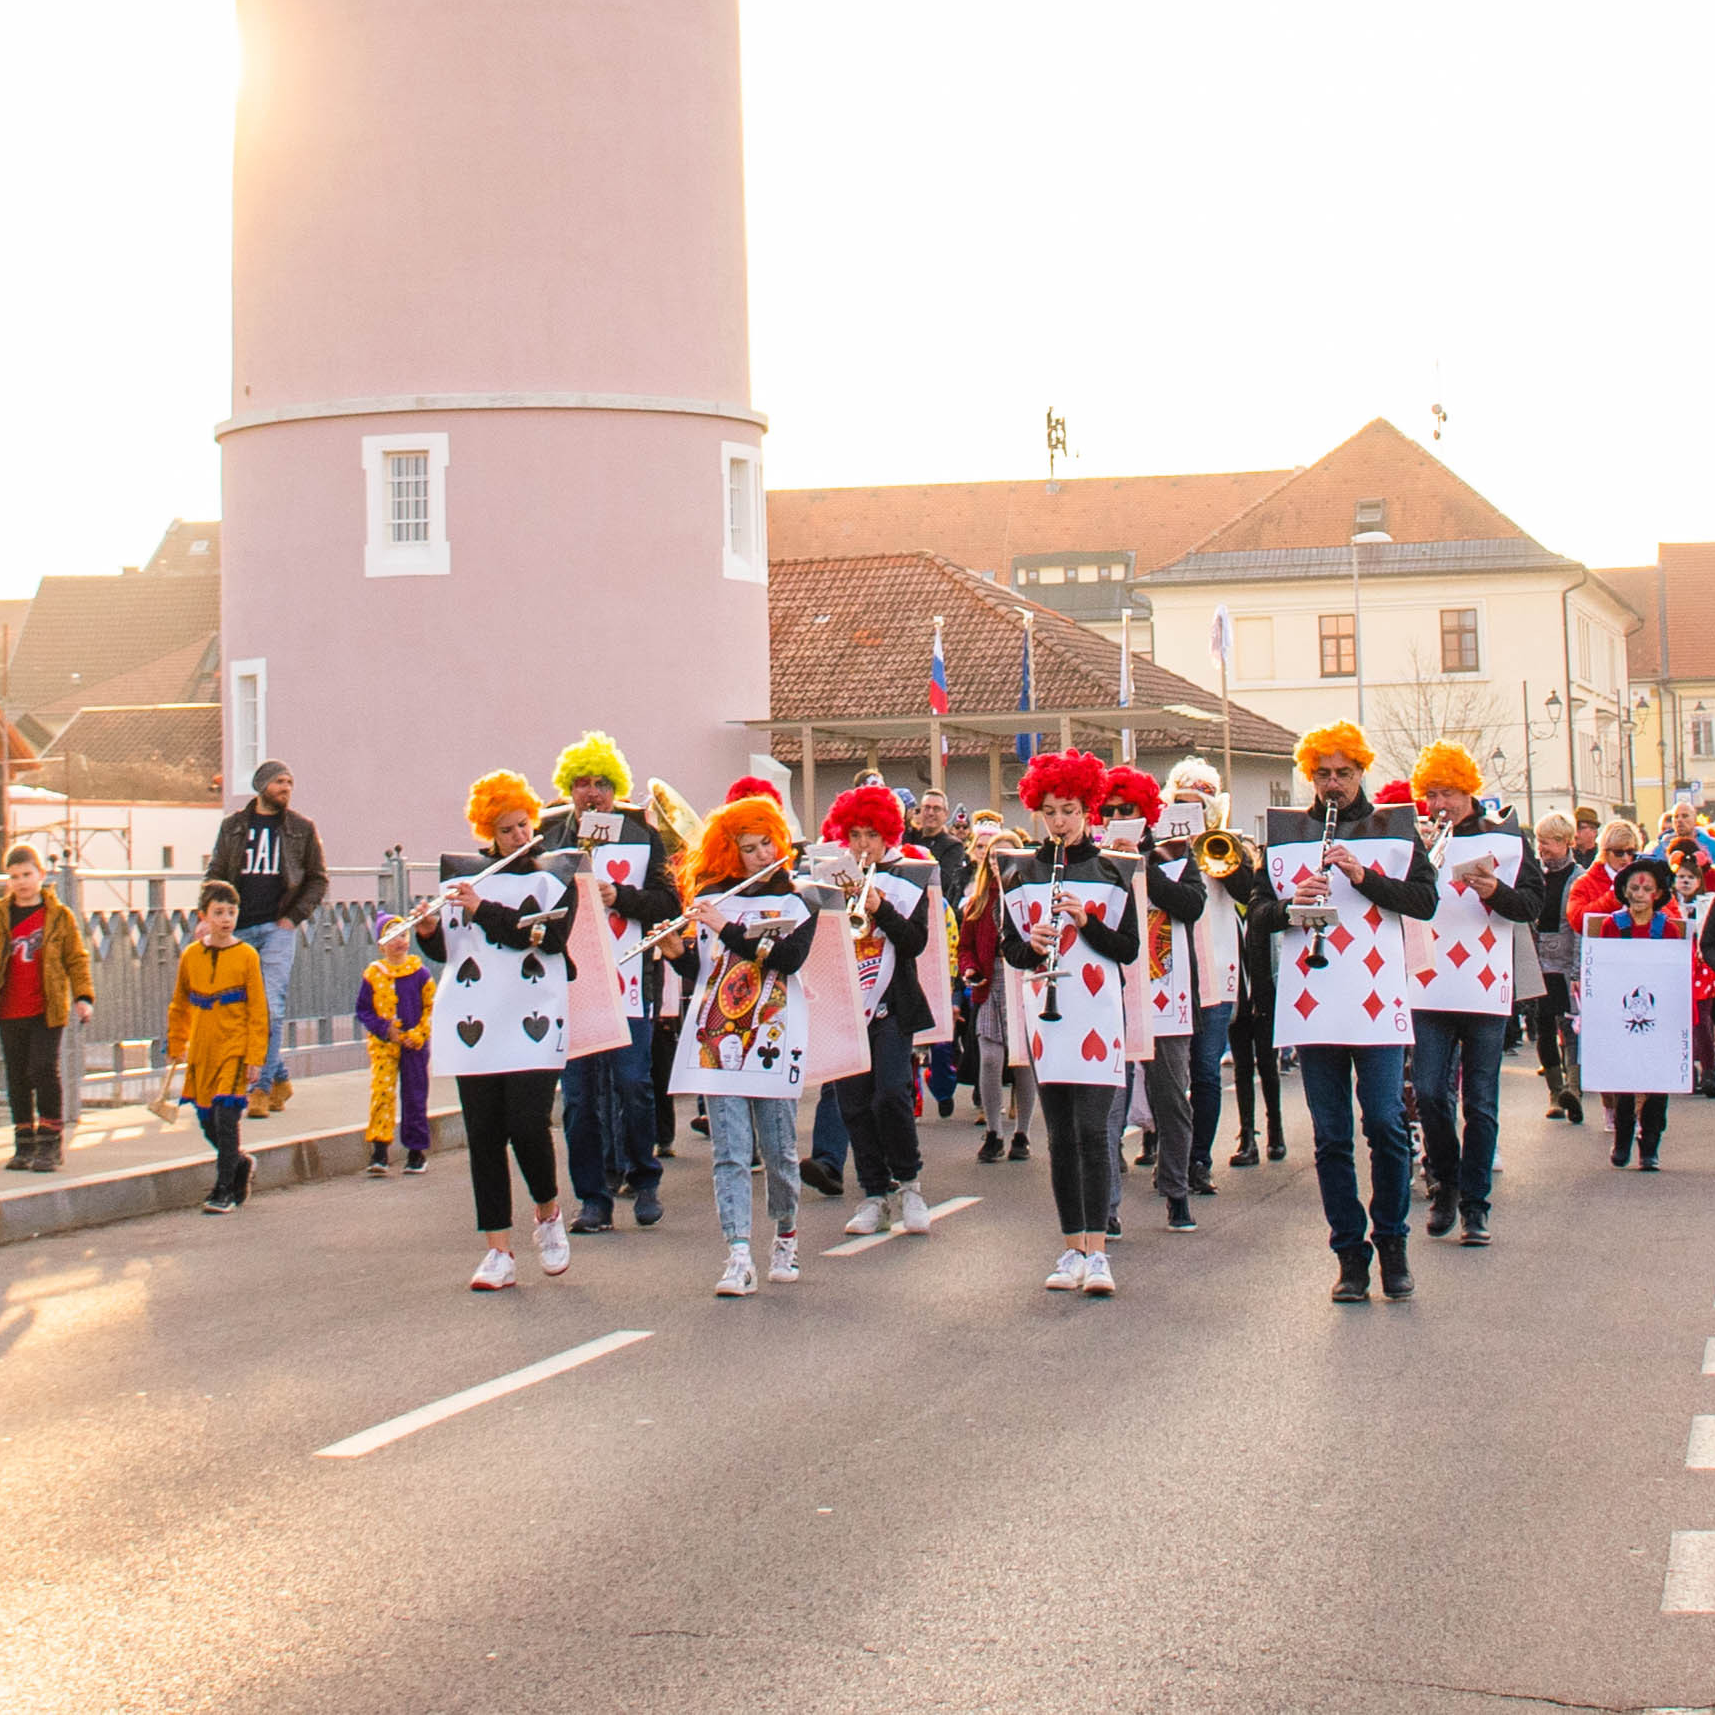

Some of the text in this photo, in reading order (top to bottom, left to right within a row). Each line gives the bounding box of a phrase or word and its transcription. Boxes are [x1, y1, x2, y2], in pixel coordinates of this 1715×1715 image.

[1272, 856, 1284, 878] 9
[1011, 899, 1025, 921] 7
[1226, 975, 1236, 992] 3
[629, 988, 639, 1006] 8
[1178, 1004, 1189, 1024] K
[789, 1063, 800, 1084] Q
[1113, 1052, 1123, 1074] 7
